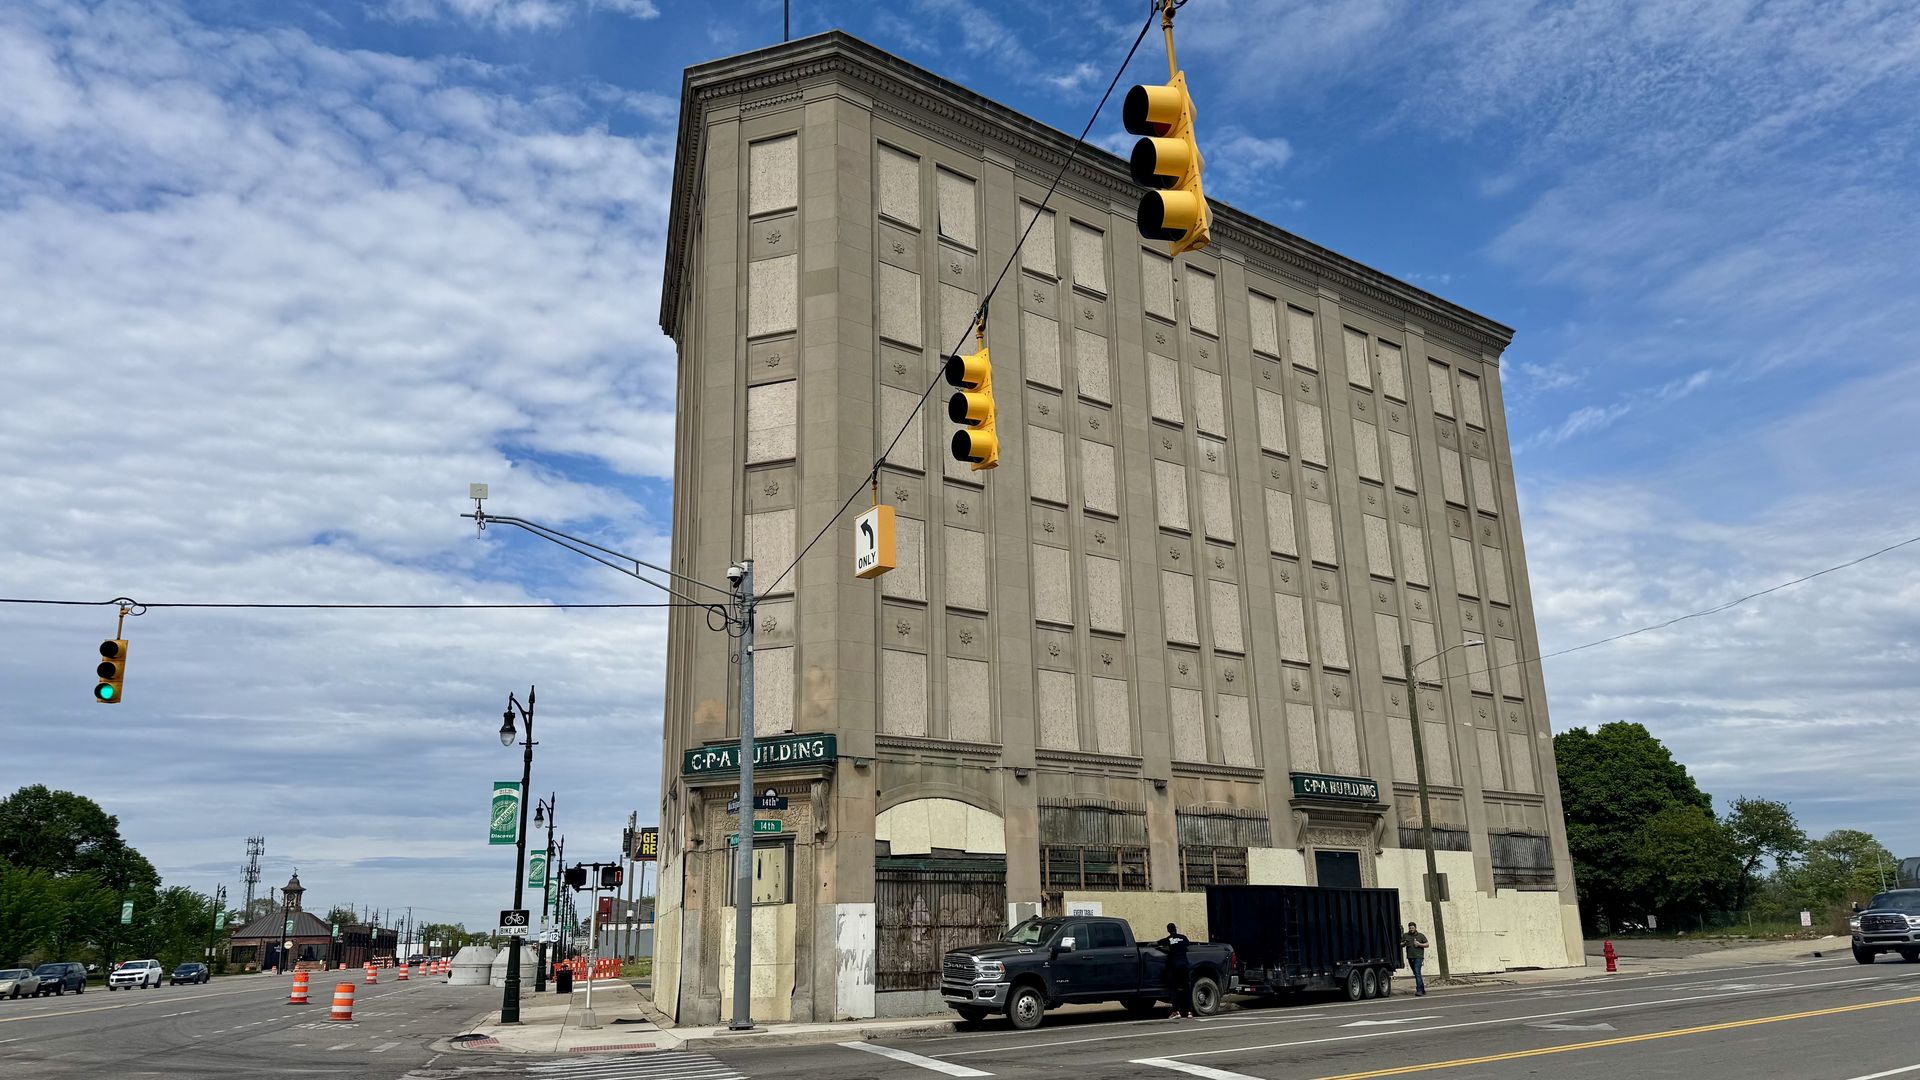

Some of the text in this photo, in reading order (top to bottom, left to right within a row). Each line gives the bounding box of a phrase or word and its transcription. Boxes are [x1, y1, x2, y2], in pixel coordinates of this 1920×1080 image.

[859, 552, 876, 568] ONLY
[738, 741, 824, 764] UILDING
[1329, 781, 1376, 797] BUILDING
[760, 822, 776, 831] 14th
[642, 832, 657, 843] GE
[642, 844, 657, 855] RE
[500, 926, 527, 935] BIKE LANE
[551, 933, 558, 941] 12
